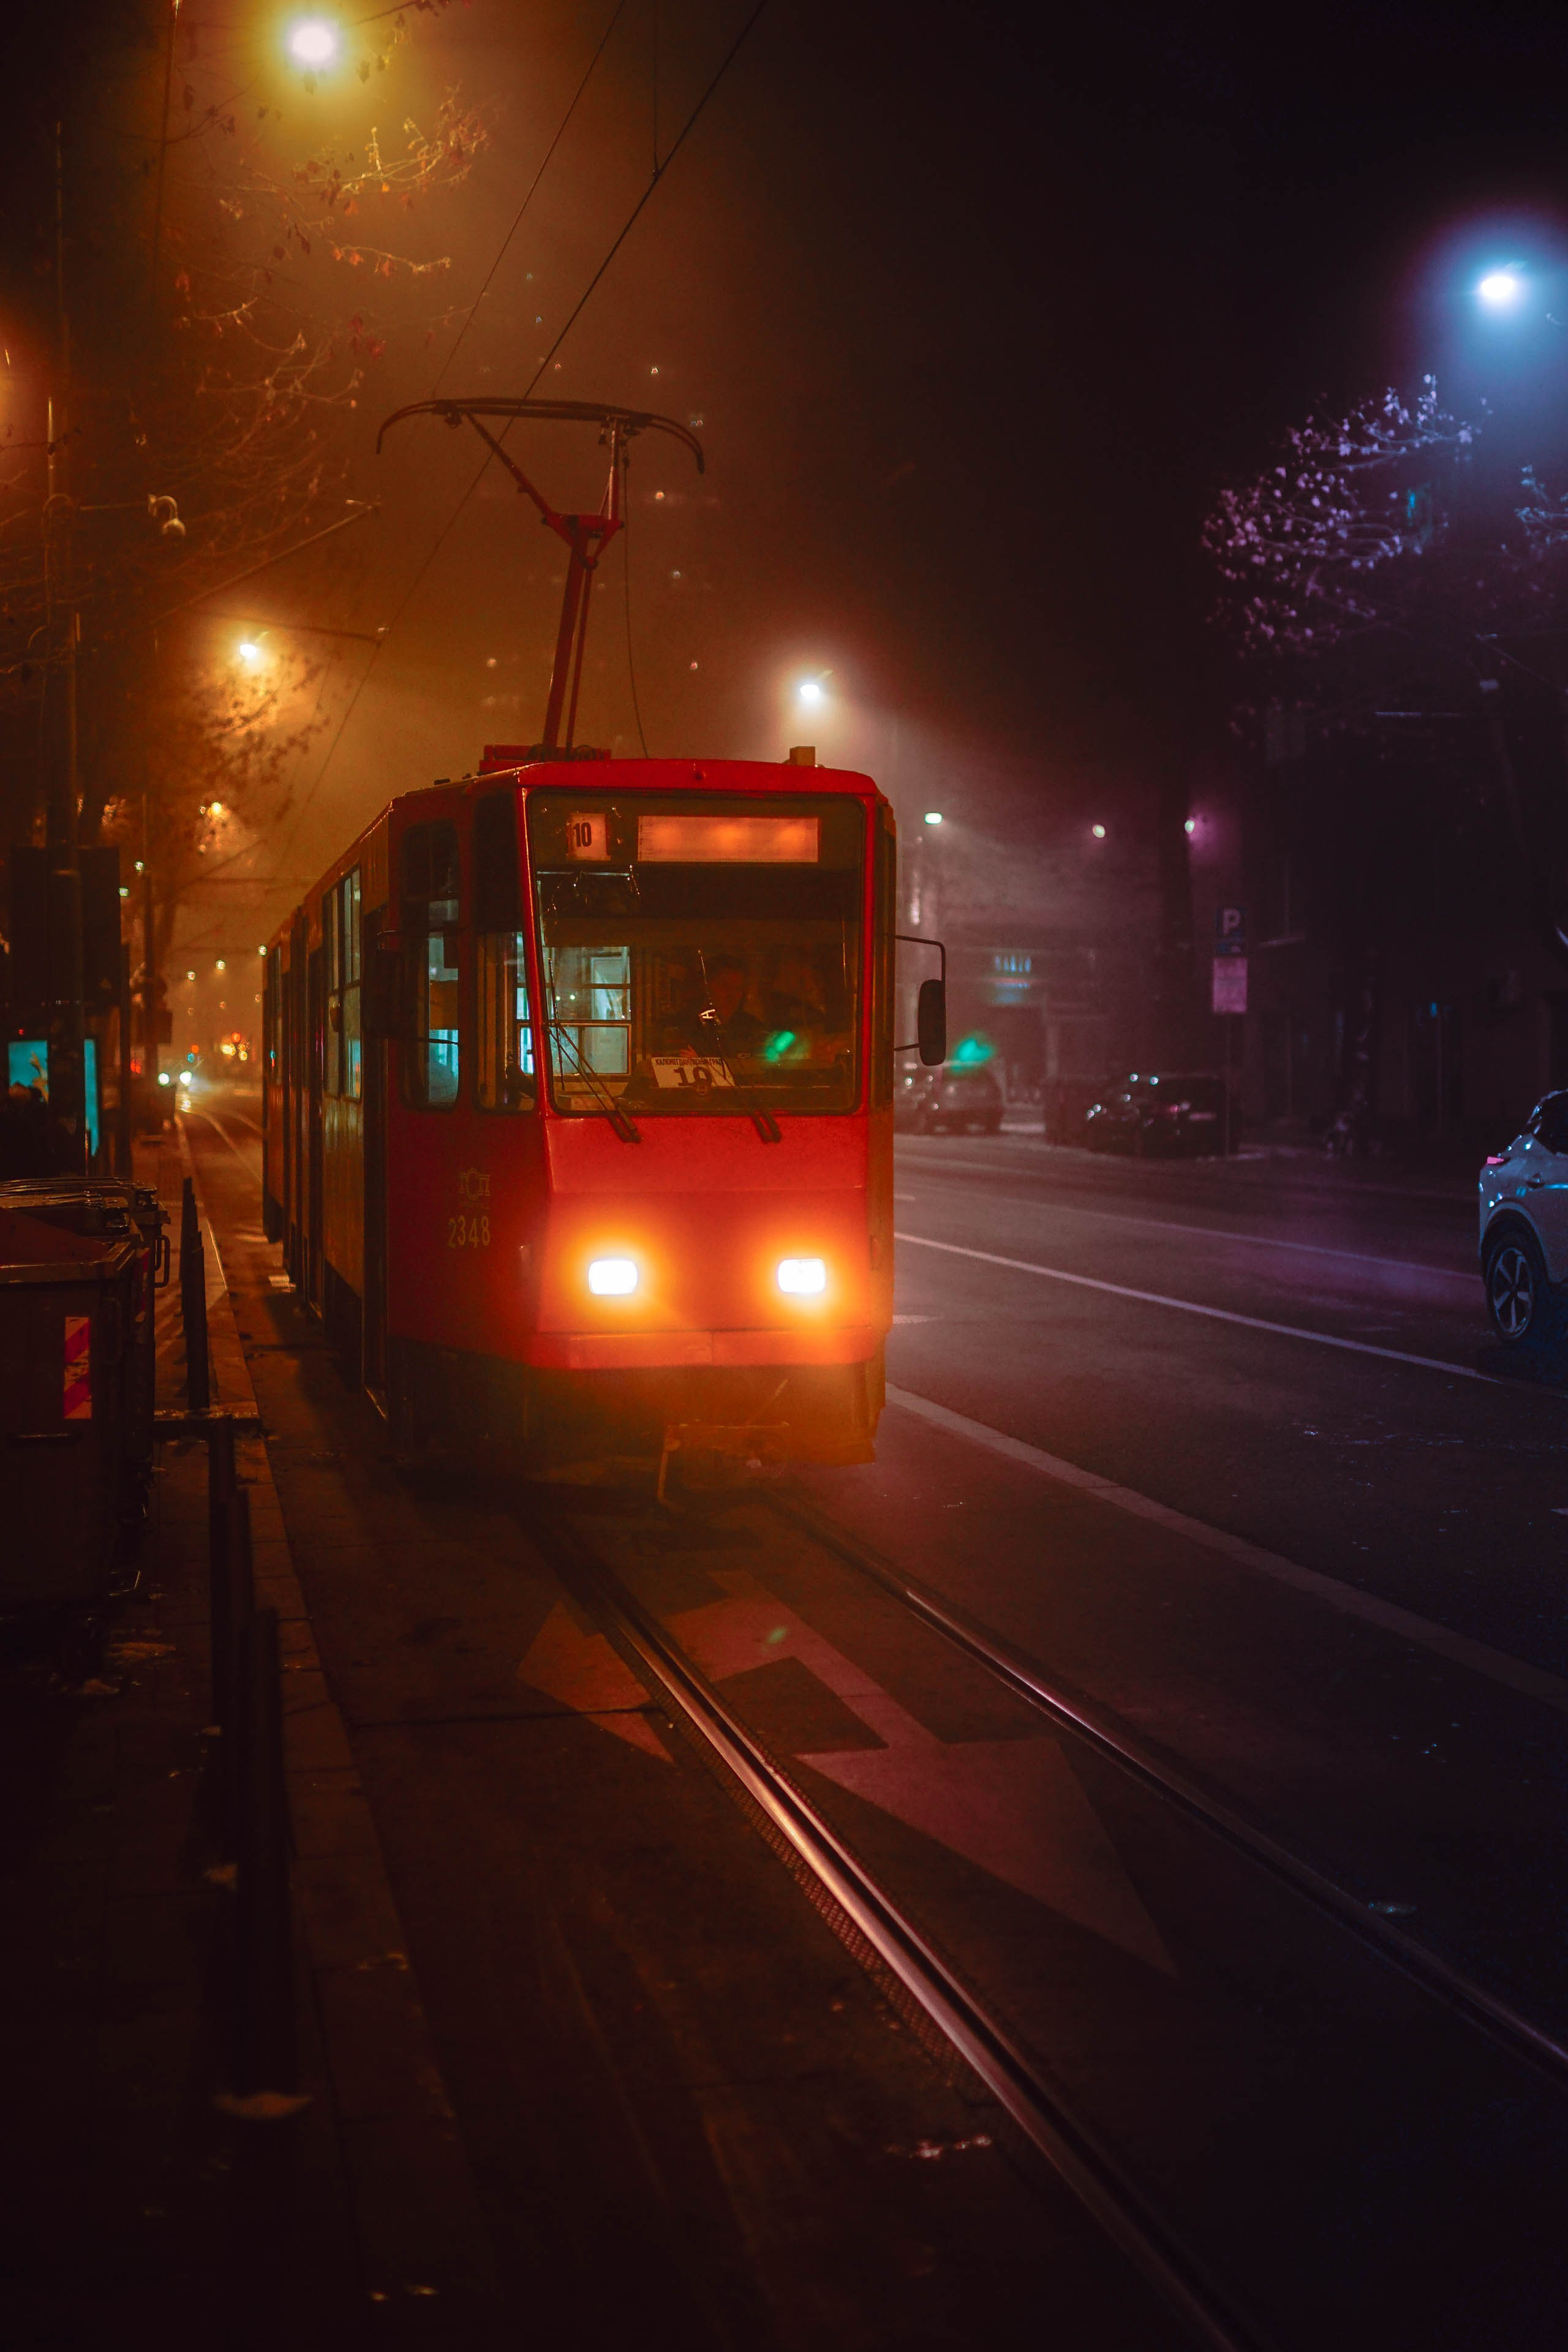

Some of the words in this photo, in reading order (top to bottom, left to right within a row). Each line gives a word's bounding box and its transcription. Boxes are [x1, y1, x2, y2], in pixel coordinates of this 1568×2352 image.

[573, 822, 592, 847] 10
[1223, 908, 1242, 935] P
[674, 1066, 712, 1087] 10
[448, 1215, 490, 1249] 2348
